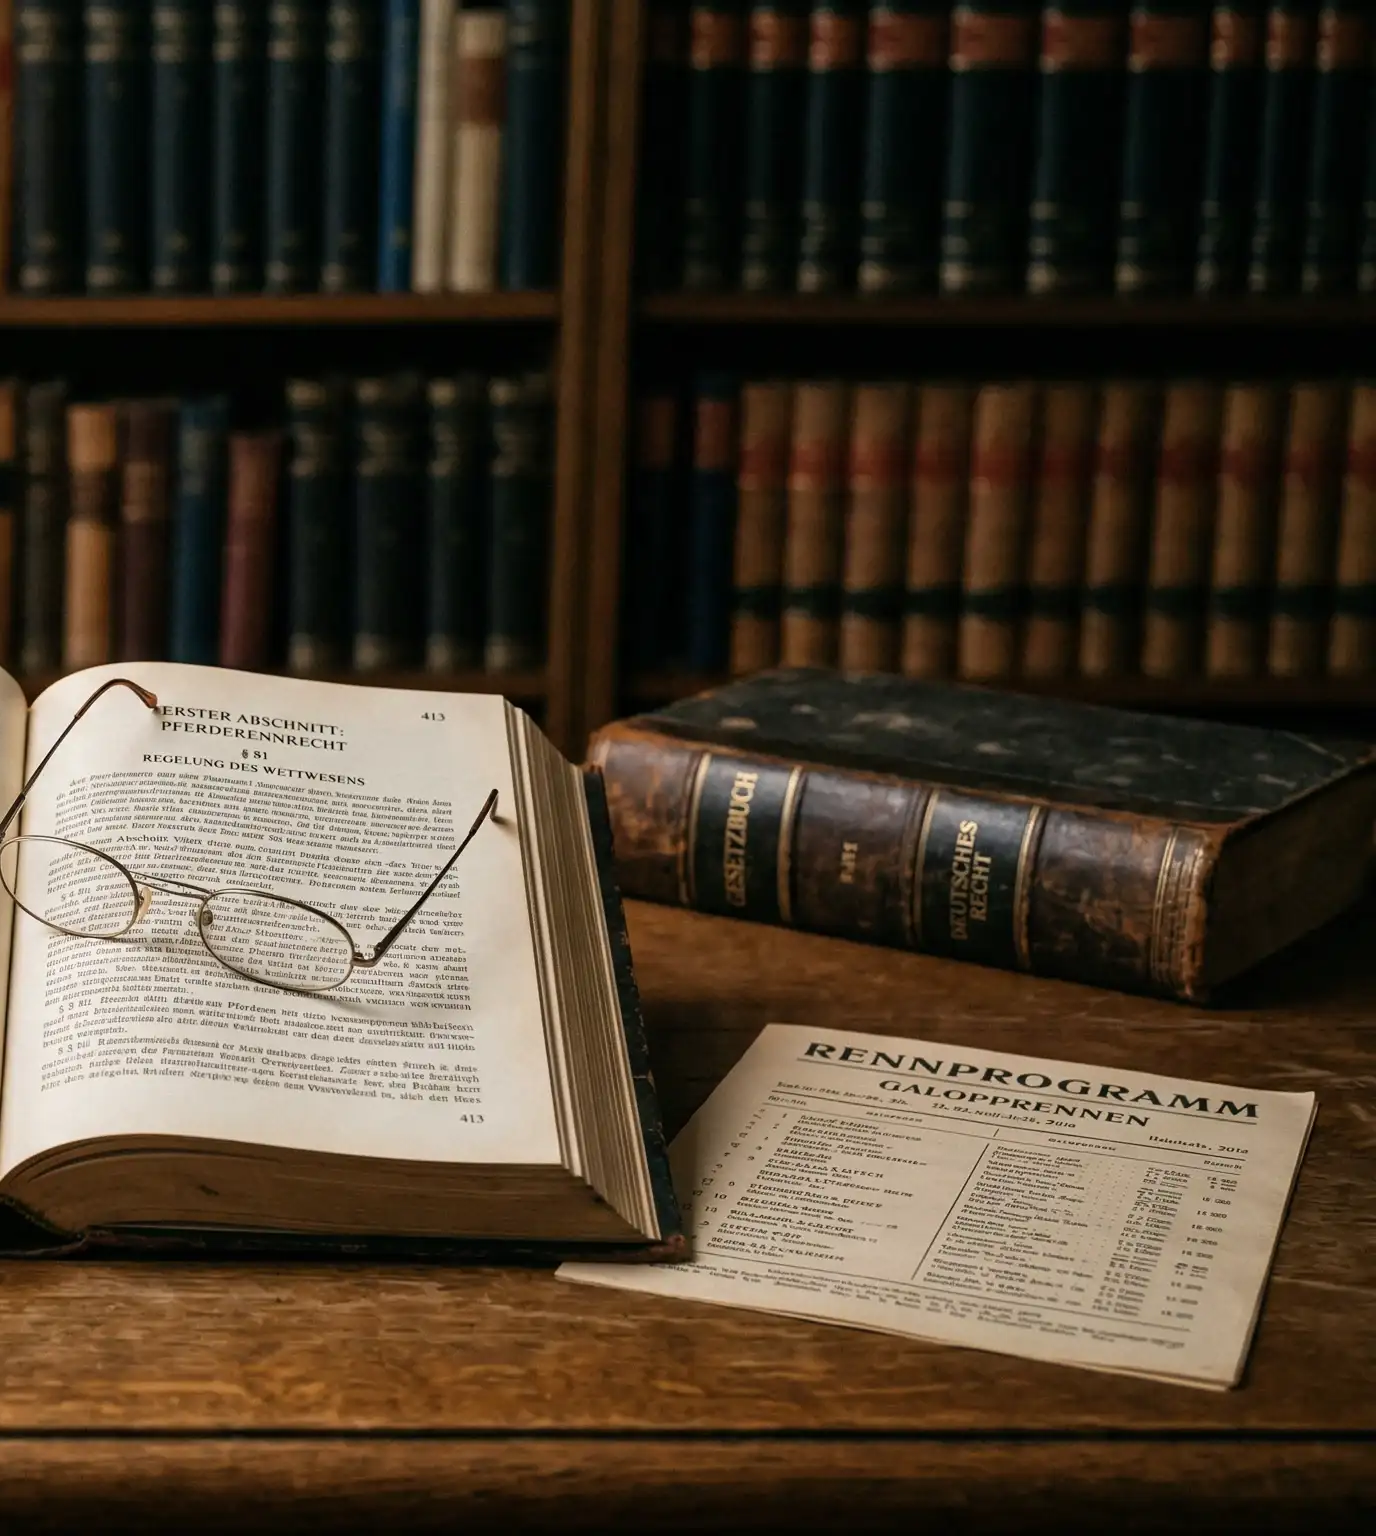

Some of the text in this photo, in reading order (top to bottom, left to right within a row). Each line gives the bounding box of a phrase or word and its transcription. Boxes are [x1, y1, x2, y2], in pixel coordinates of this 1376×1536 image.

[161, 705, 345, 737] ERSTER ABSCHNITT:
[161, 721, 348, 752] PFERDERENNRECHT
[421, 711, 446, 722] 413
[143, 753, 366, 787] REGELUNG DES WETTWESENS
[724, 772, 759, 907] GESETZBUCH
[950, 820, 979, 940] DEUTSCHES
[970, 851, 992, 921] RECHT
[804, 1041, 1260, 1119] RENNPROGRAMM
[459, 1114, 485, 1125] 413
[879, 1080, 1151, 1128] GALOPPRENNEN
